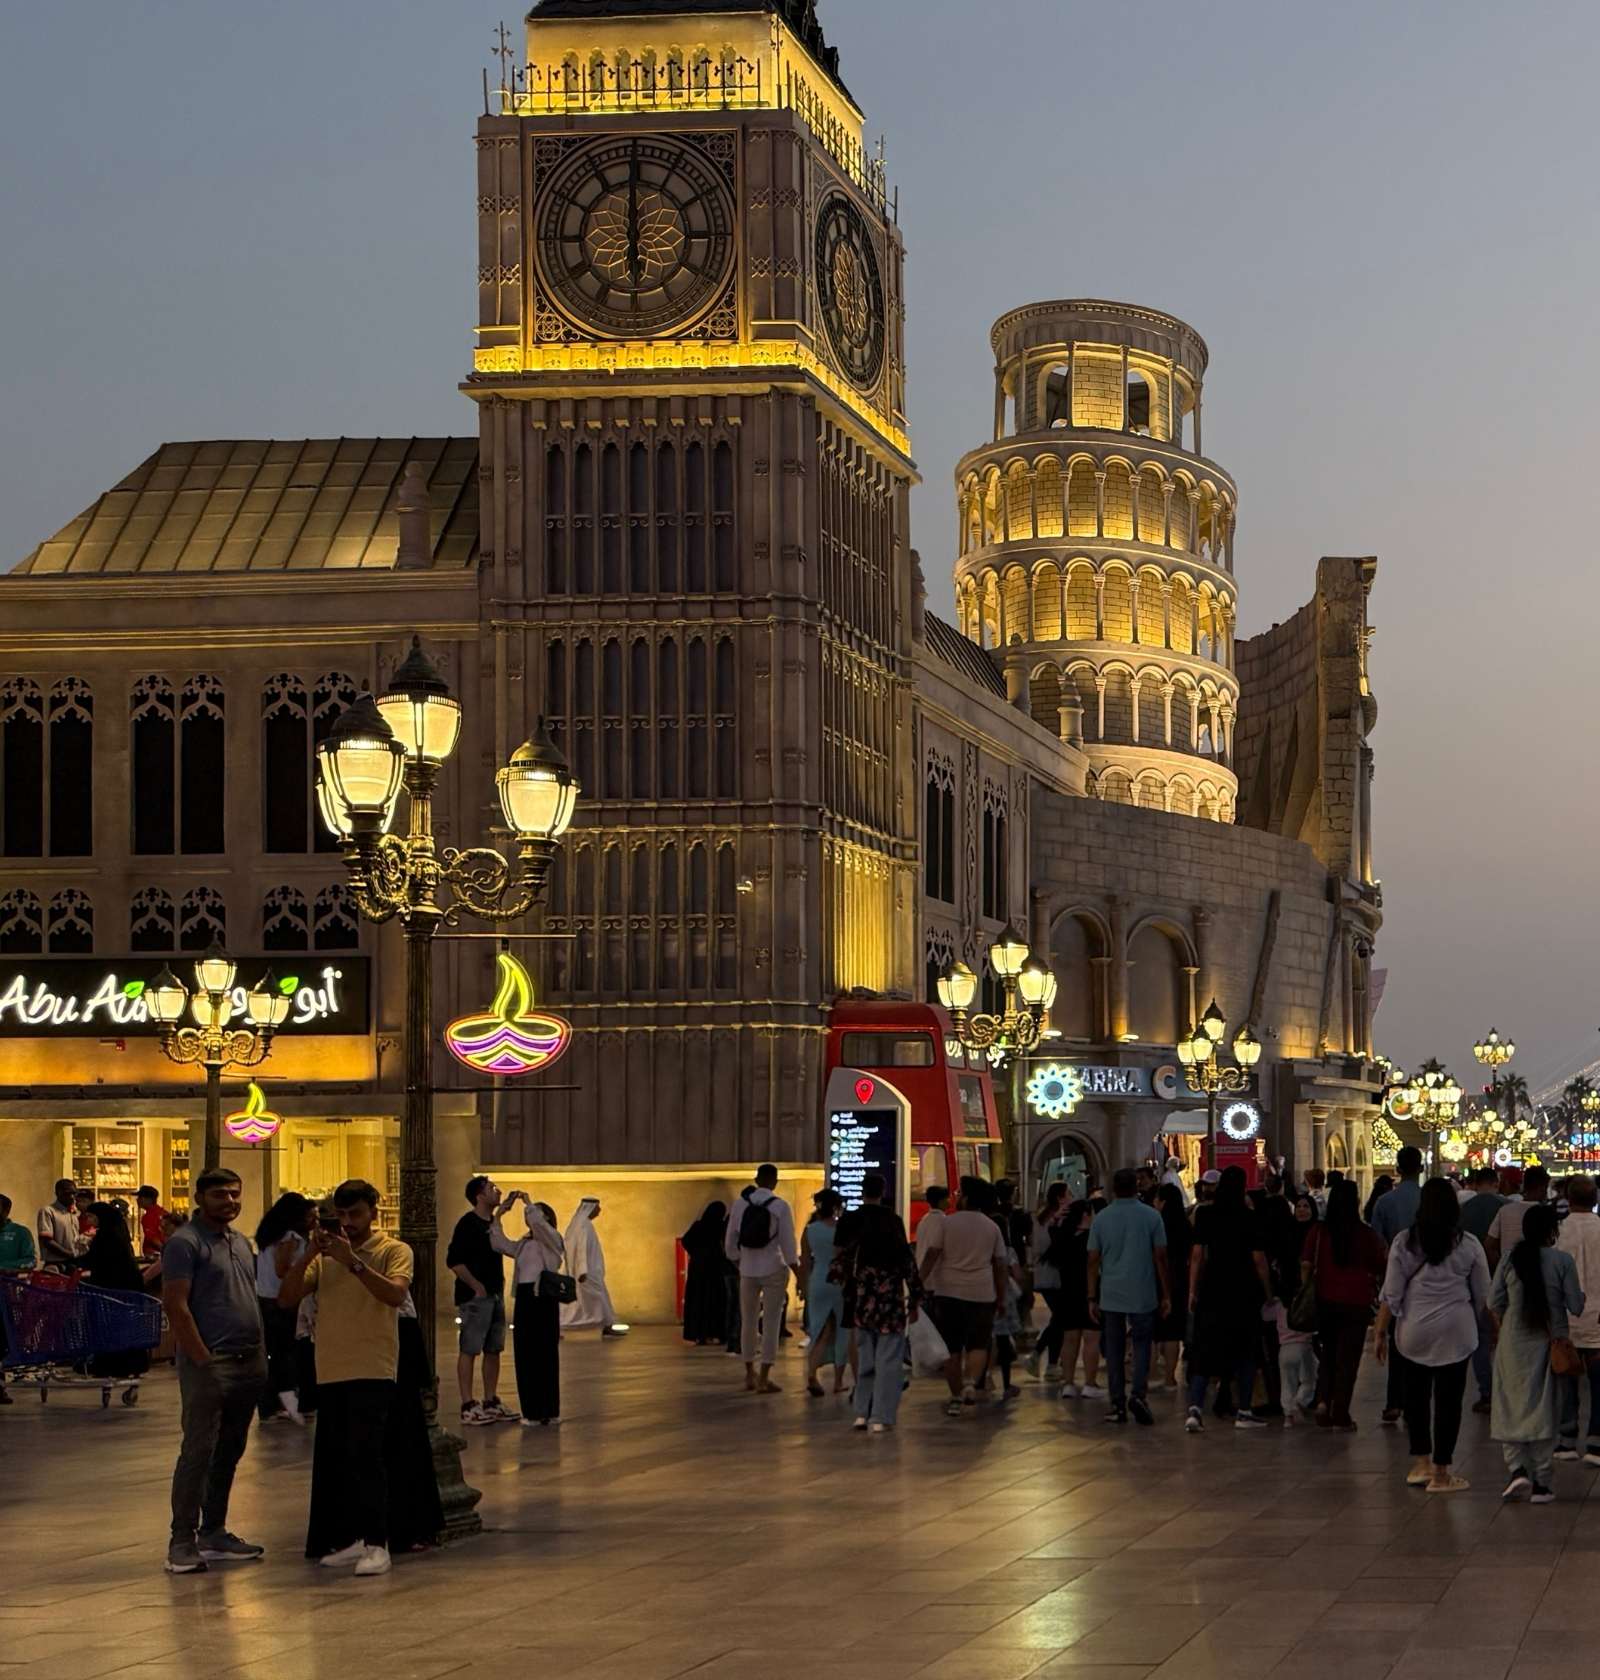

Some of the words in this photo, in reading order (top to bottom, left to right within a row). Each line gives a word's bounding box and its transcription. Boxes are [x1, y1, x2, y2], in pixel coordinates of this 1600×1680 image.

[0, 974, 80, 1025] Abu
[82, 973, 148, 1024] Au
[293, 966, 343, 1024] أبو
